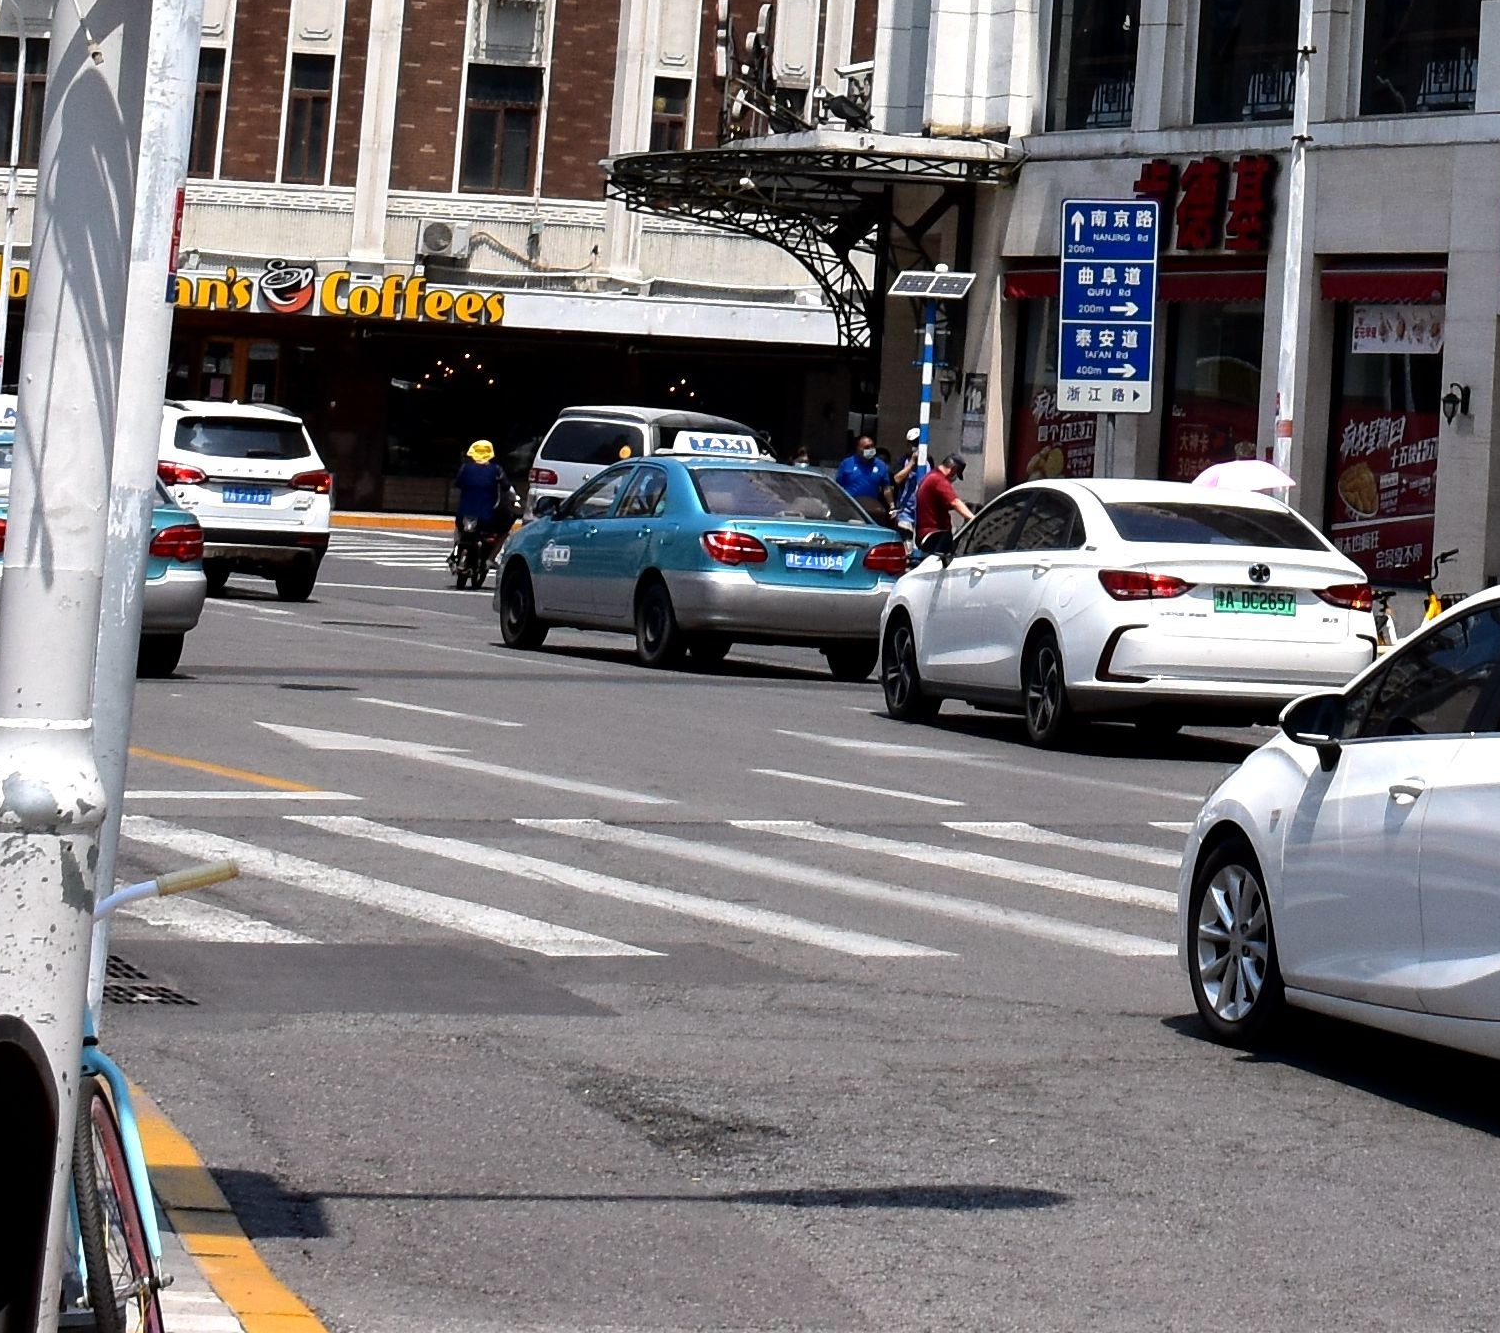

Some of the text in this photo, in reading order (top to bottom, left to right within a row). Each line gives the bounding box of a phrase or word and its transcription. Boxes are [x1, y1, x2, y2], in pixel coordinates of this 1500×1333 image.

[1091, 210, 1153, 229] 南京路
[1093, 233, 1149, 242] NANJING Rd
[1067, 245, 1095, 254] 200m
[1078, 267, 1141, 285] 曲阜道
[322, 270, 505, 324] Coffees
[1087, 289, 1131, 297] QUFU Rd
[1078, 305, 1104, 313] 200m
[1076, 329, 1139, 348] 泰安道
[1116, 351, 1129, 359] Rd
[1076, 366, 1102, 375] 400m
[1066, 386, 1125, 403] 浙江路
[695, 436, 750, 450] TAXI
